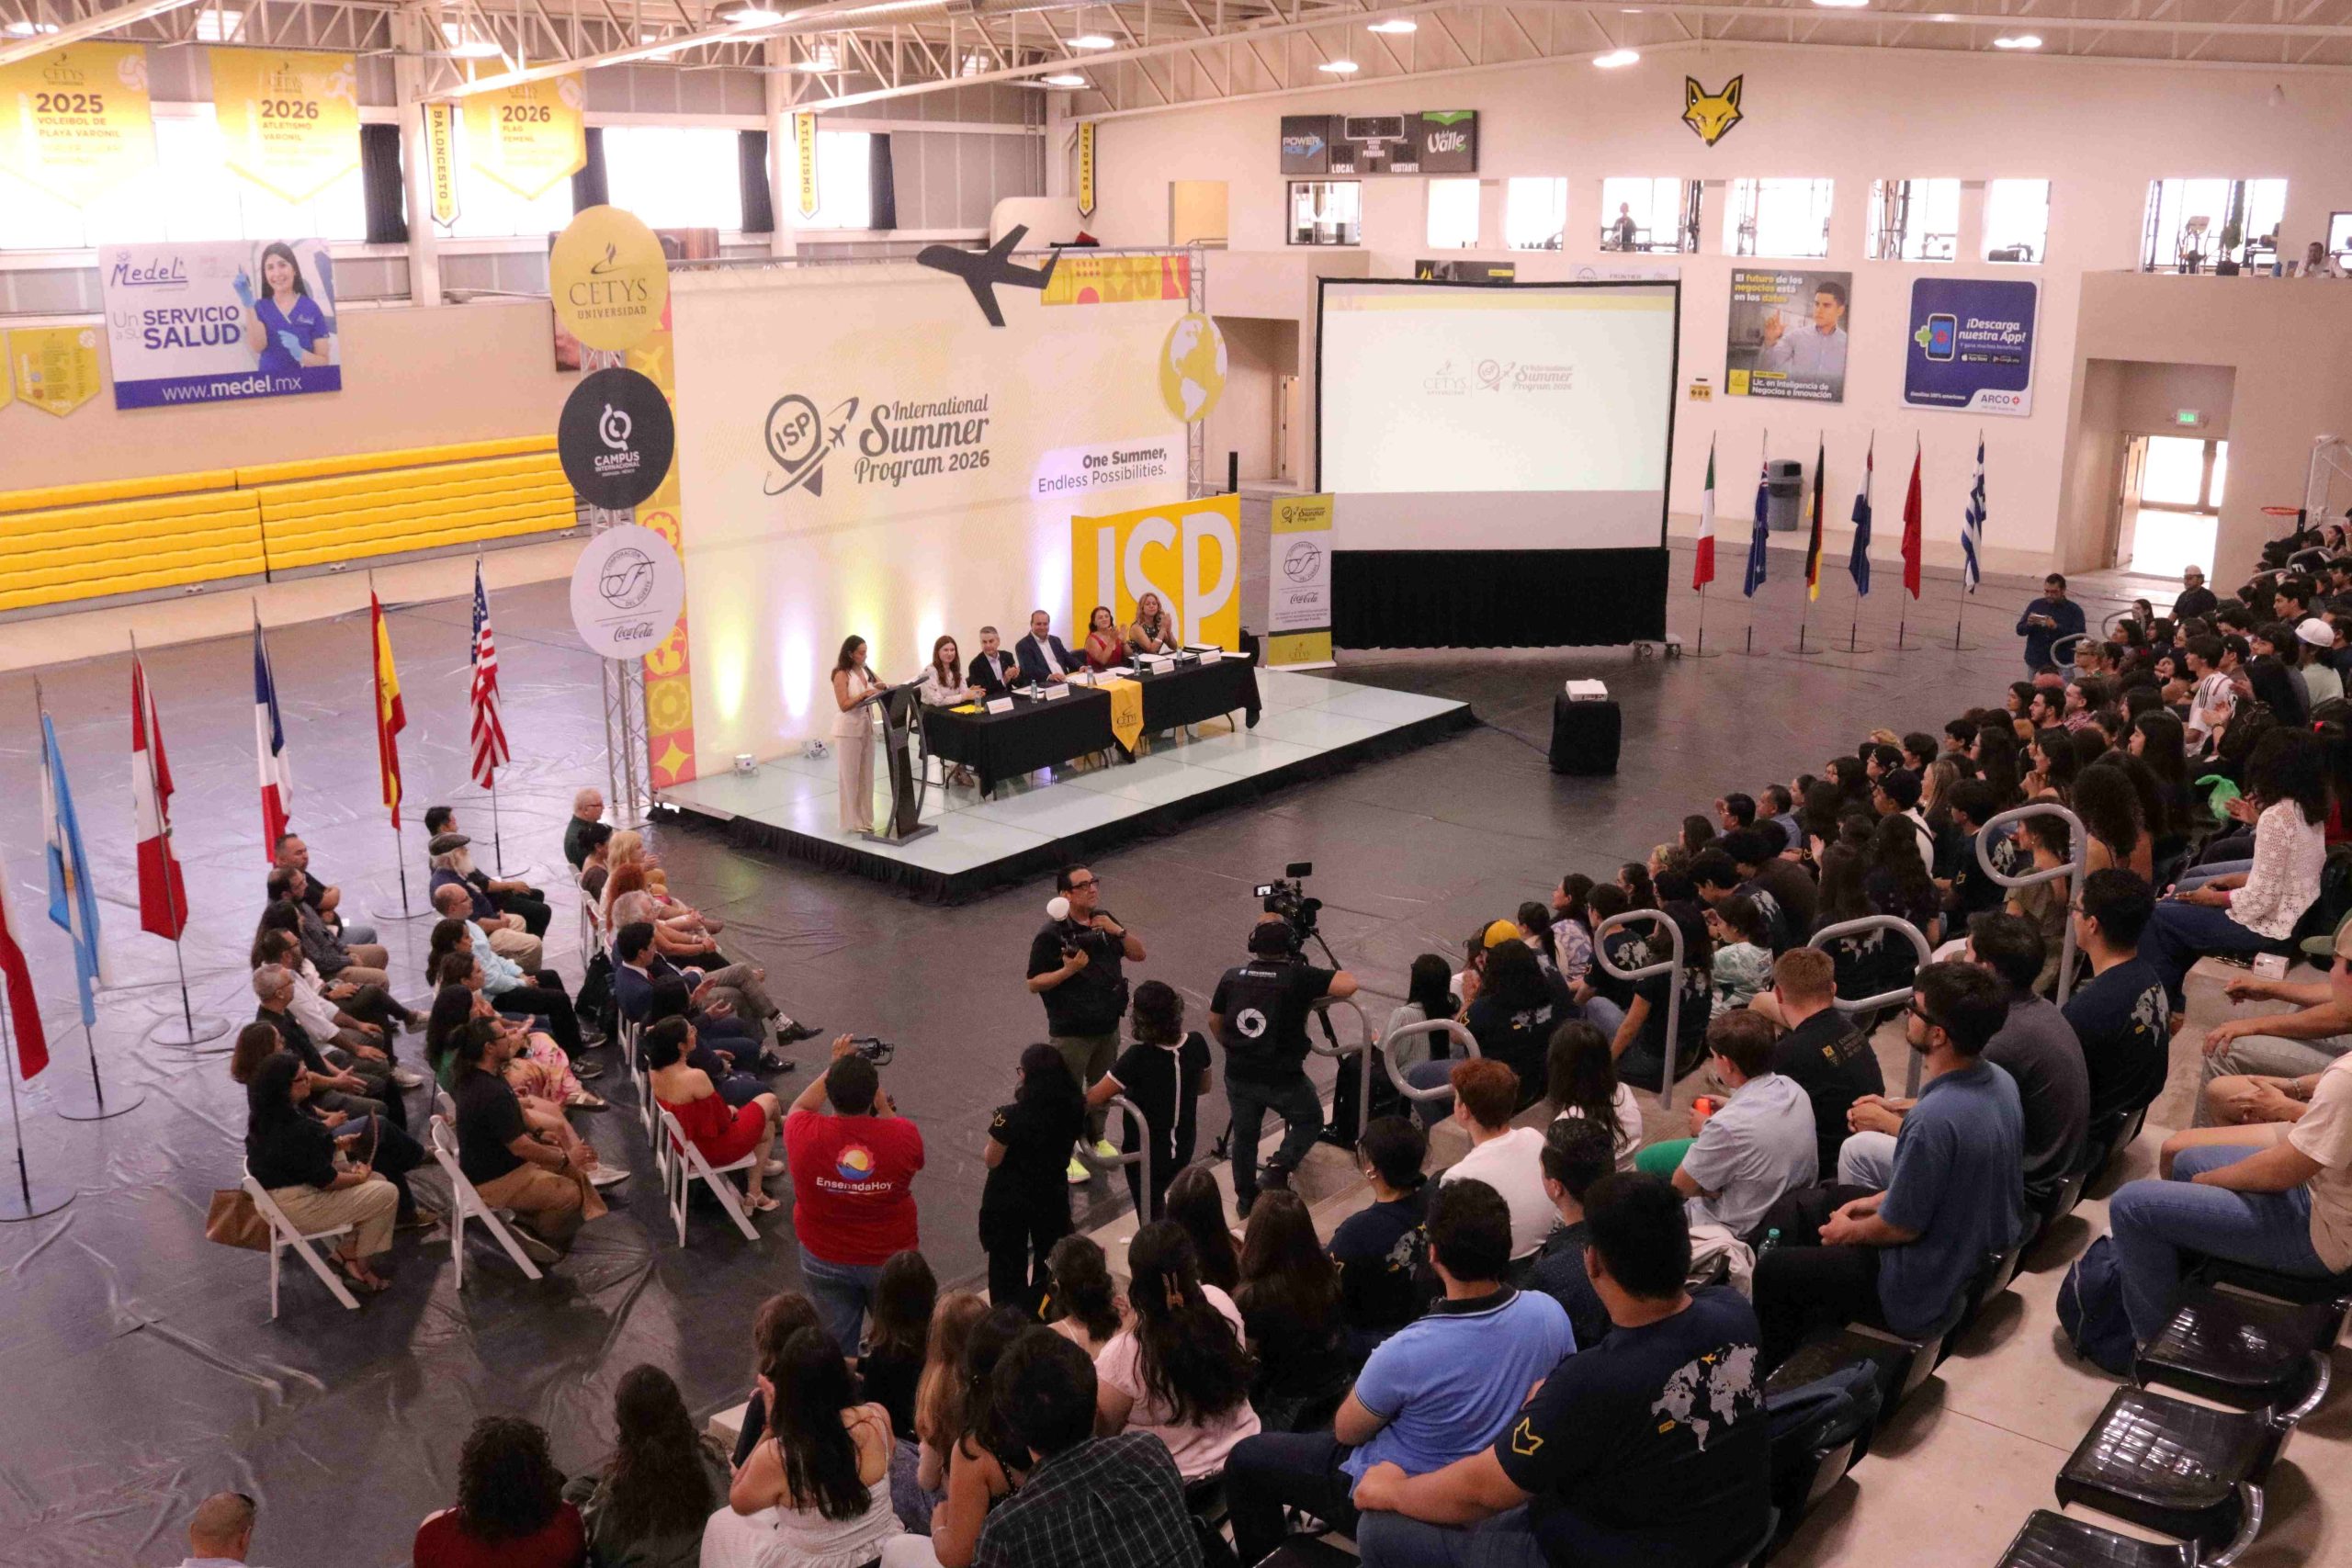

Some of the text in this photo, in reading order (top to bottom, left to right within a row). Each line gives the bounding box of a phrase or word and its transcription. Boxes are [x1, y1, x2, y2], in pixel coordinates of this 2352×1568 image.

[36, 93, 104, 114] 2025
[261, 99, 319, 119] 2026
[38, 118, 107, 126] VOLEIBOL DE
[503, 106, 550, 123] 2026
[263, 121, 312, 130] ATLETISMO
[74, 130, 120, 138] VARONIL
[1283, 137, 1320, 146] POWER
[1440, 130, 1449, 140] del
[1427, 132, 1465, 154] Valle
[434, 110, 448, 199] BALONCESTO
[800, 119, 811, 194] ATLETISMO
[1331, 164, 1355, 174] LOCAL
[1390, 163, 1419, 173] VISITANTE
[1735, 274, 1803, 285] El futuro de los
[569, 278, 648, 307] CETYS
[1735, 284, 1796, 293] negocios está
[1747, 293, 1760, 301] los
[1762, 294, 1788, 302] datos
[113, 305, 239, 329] Un SERVICIO
[577, 306, 647, 320] UNIVERSIDAD
[1967, 318, 2020, 333] ¡Descarga
[143, 323, 241, 350] SALUD
[1958, 331, 2026, 344] nuestra App!
[1515, 365, 1573, 382] Summer
[162, 375, 302, 401] www.medel.mx
[1423, 377, 1467, 389] CETYS
[1513, 381, 1550, 392] Program
[1777, 380, 1817, 390] Inteligencia
[1752, 387, 1785, 395] Negocios
[1793, 389, 1832, 399] Innovación
[1981, 394, 2010, 404] ARCO
[892, 393, 989, 421] International
[775, 412, 811, 453] ISP
[859, 404, 989, 457] Summer
[594, 451, 640, 467] CAMPUS
[1082, 448, 1167, 468] One Summer,
[595, 461, 640, 473] INTERNACIONAL
[854, 449, 989, 488] Program 2026
[1038, 464, 1167, 492] Endless Possibilities.
[1098, 511, 1238, 646] ISP
[816, 1177, 892, 1191] EnsenadaHoy
